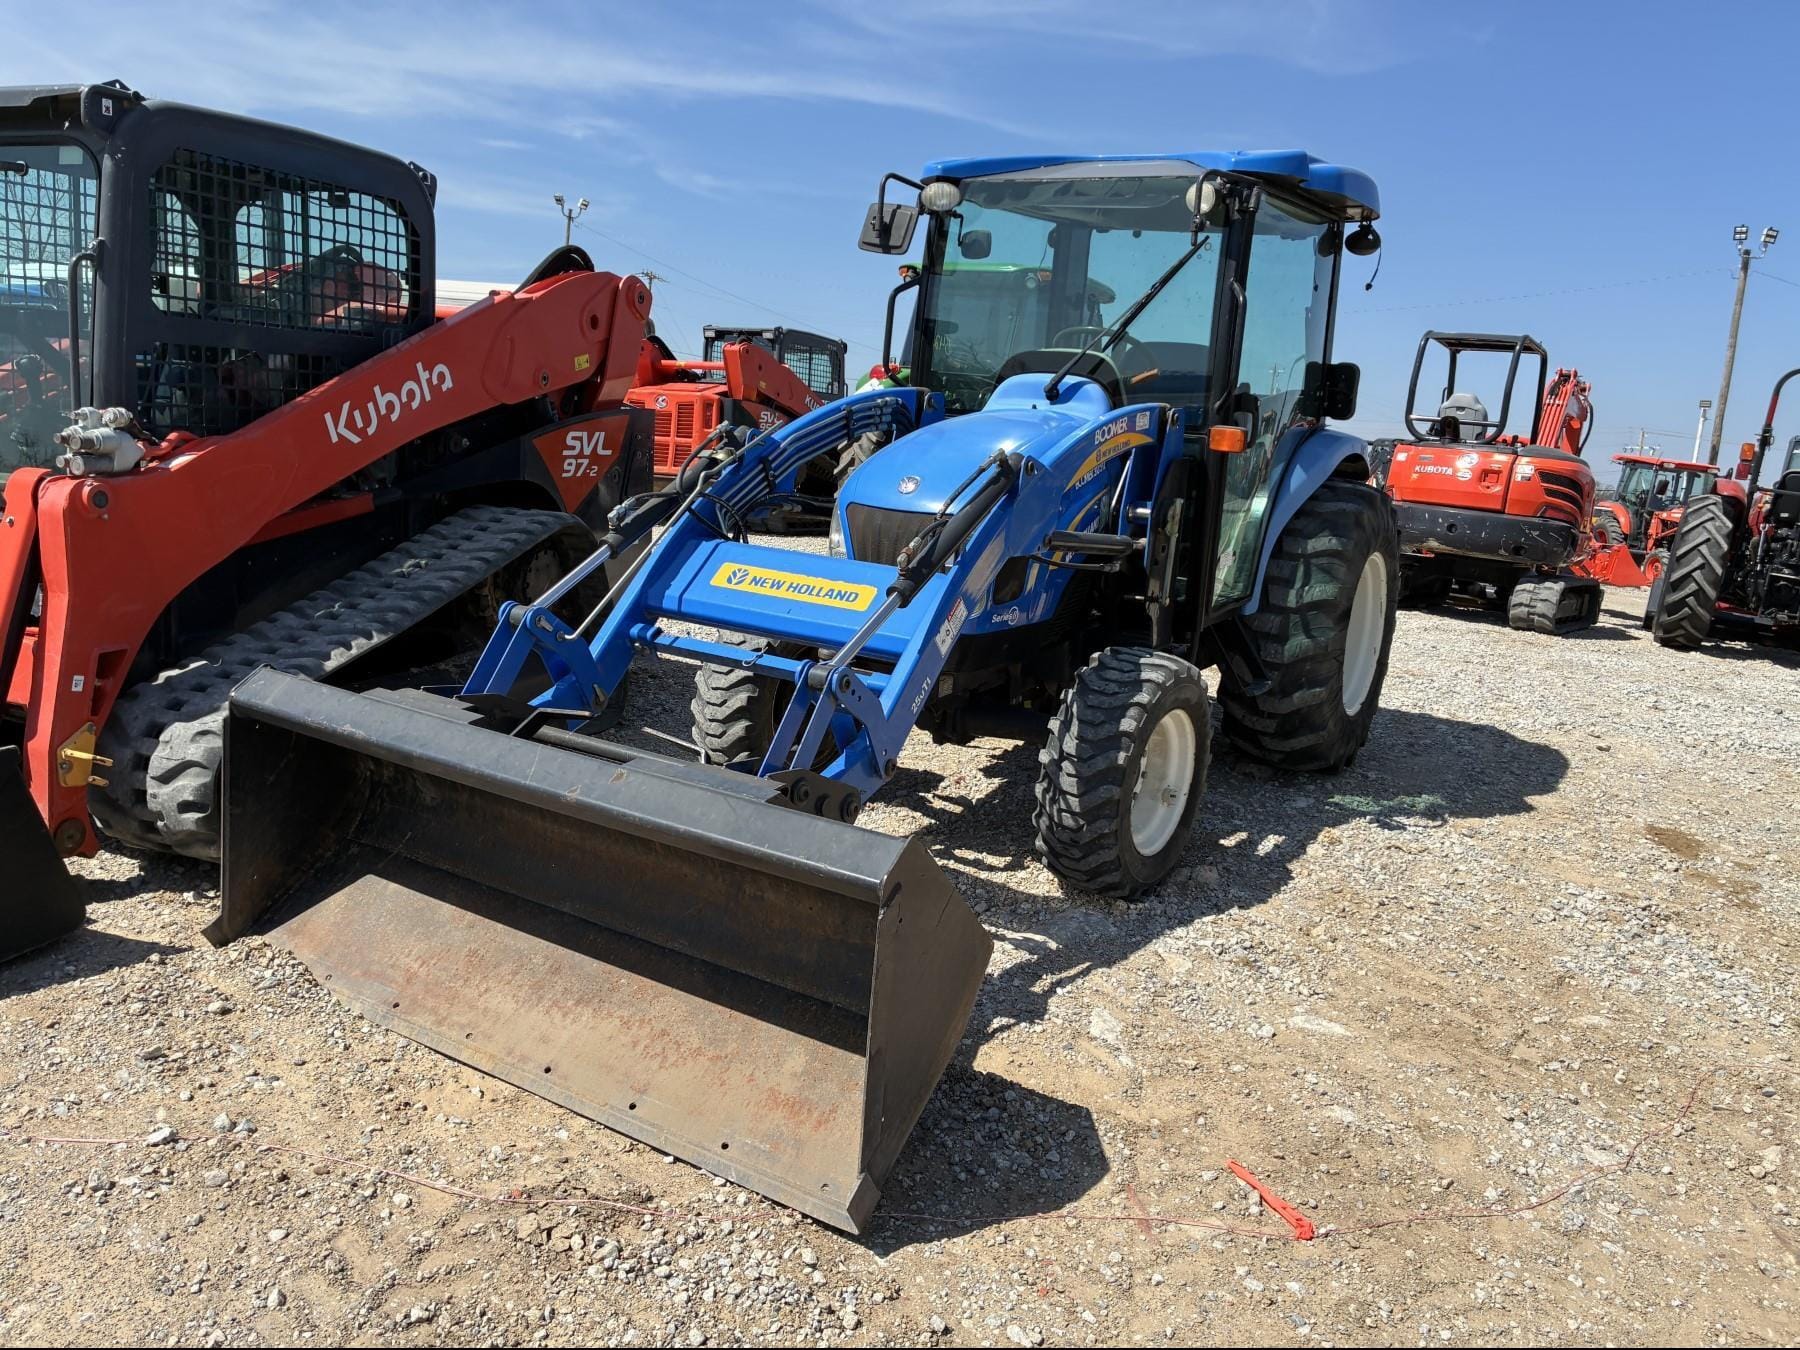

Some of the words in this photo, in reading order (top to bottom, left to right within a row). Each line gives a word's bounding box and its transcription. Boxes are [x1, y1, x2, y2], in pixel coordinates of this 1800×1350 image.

[323, 360, 454, 444] Kubota
[562, 430, 613, 456] SVL
[1094, 416, 1128, 445] BOOMER
[561, 458, 599, 477] 97-2
[1414, 464, 1453, 475] KUBOTA
[748, 575, 787, 589] NEW
[786, 582, 860, 603] HOLLAND
